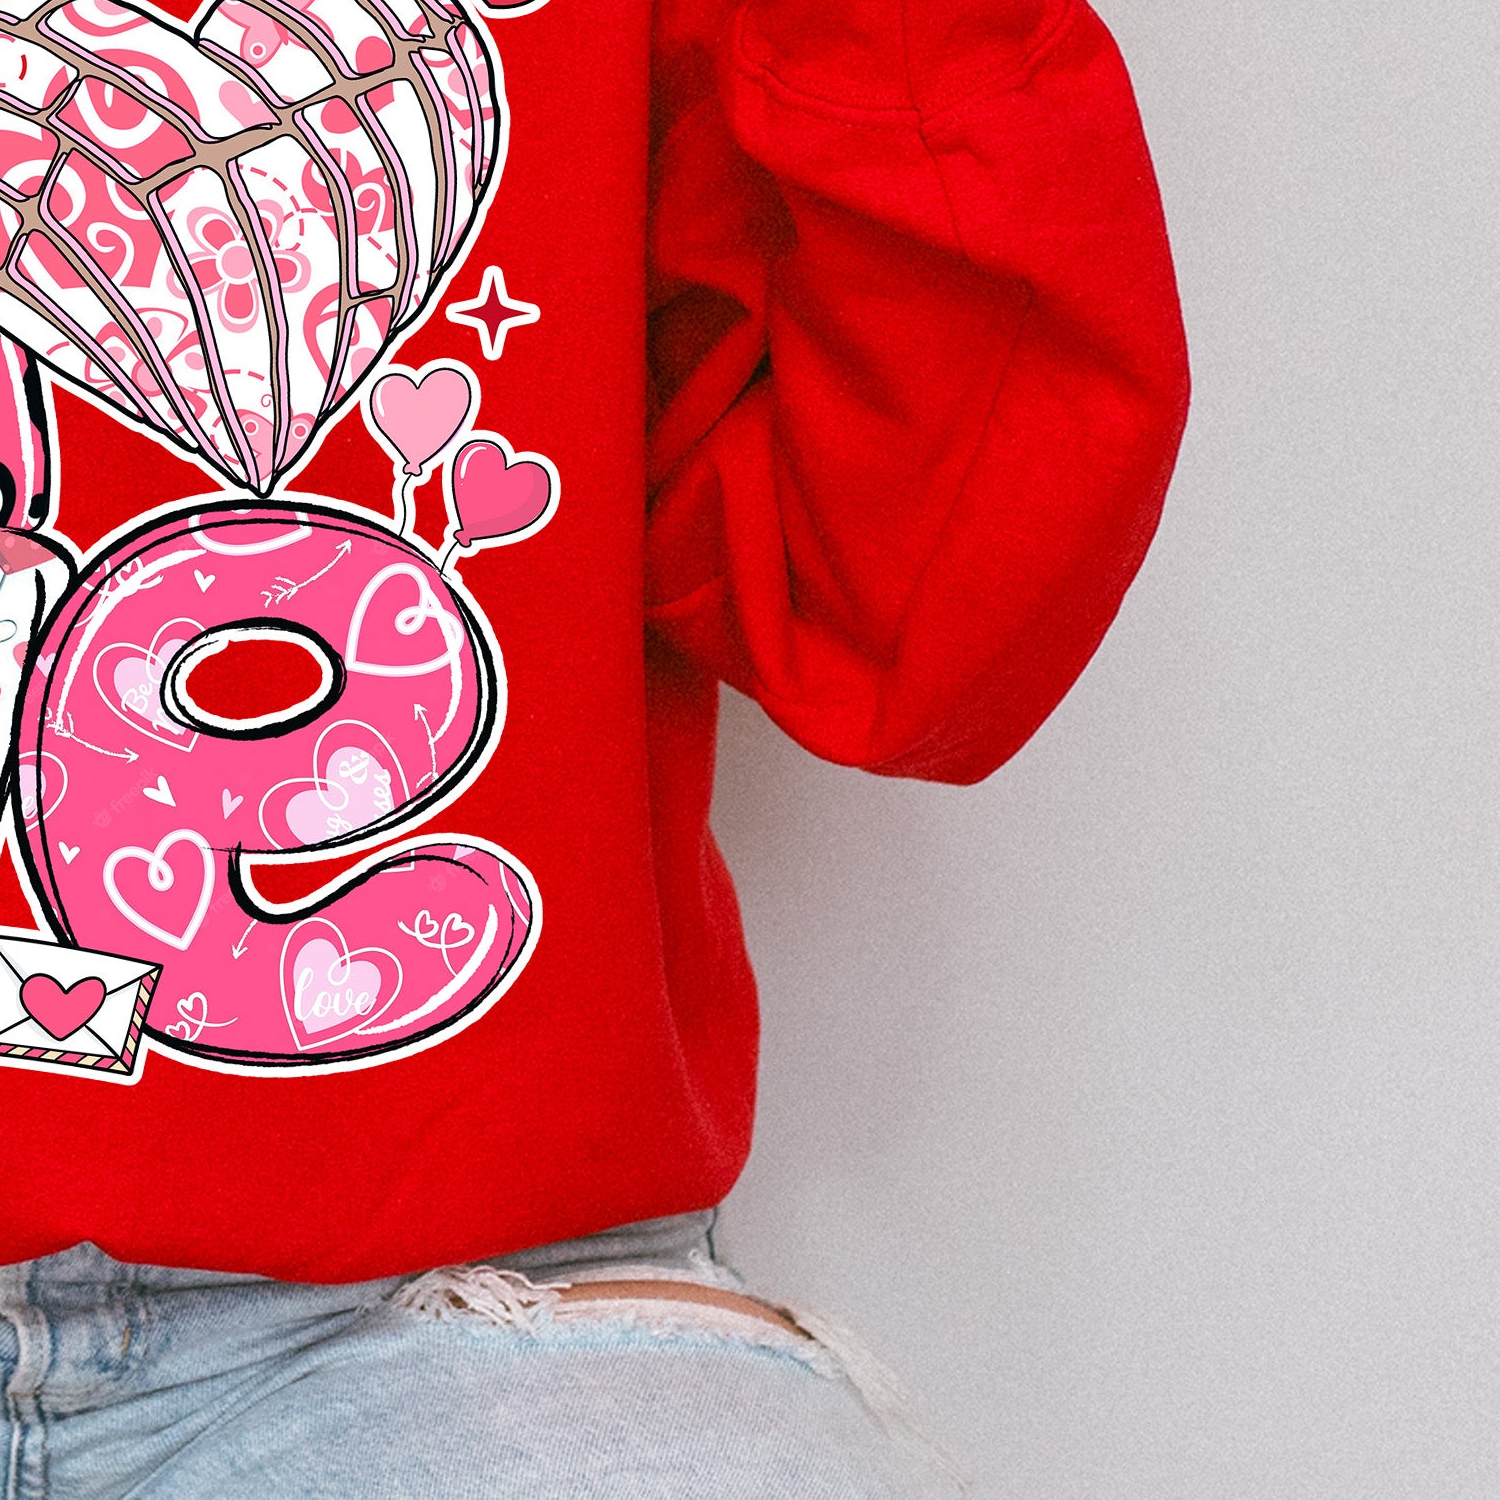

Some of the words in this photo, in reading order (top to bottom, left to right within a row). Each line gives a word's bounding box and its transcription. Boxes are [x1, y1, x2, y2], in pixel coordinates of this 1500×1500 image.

[121, 682, 153, 715] Be
[338, 751, 370, 785] &
[294, 967, 377, 1021] love
